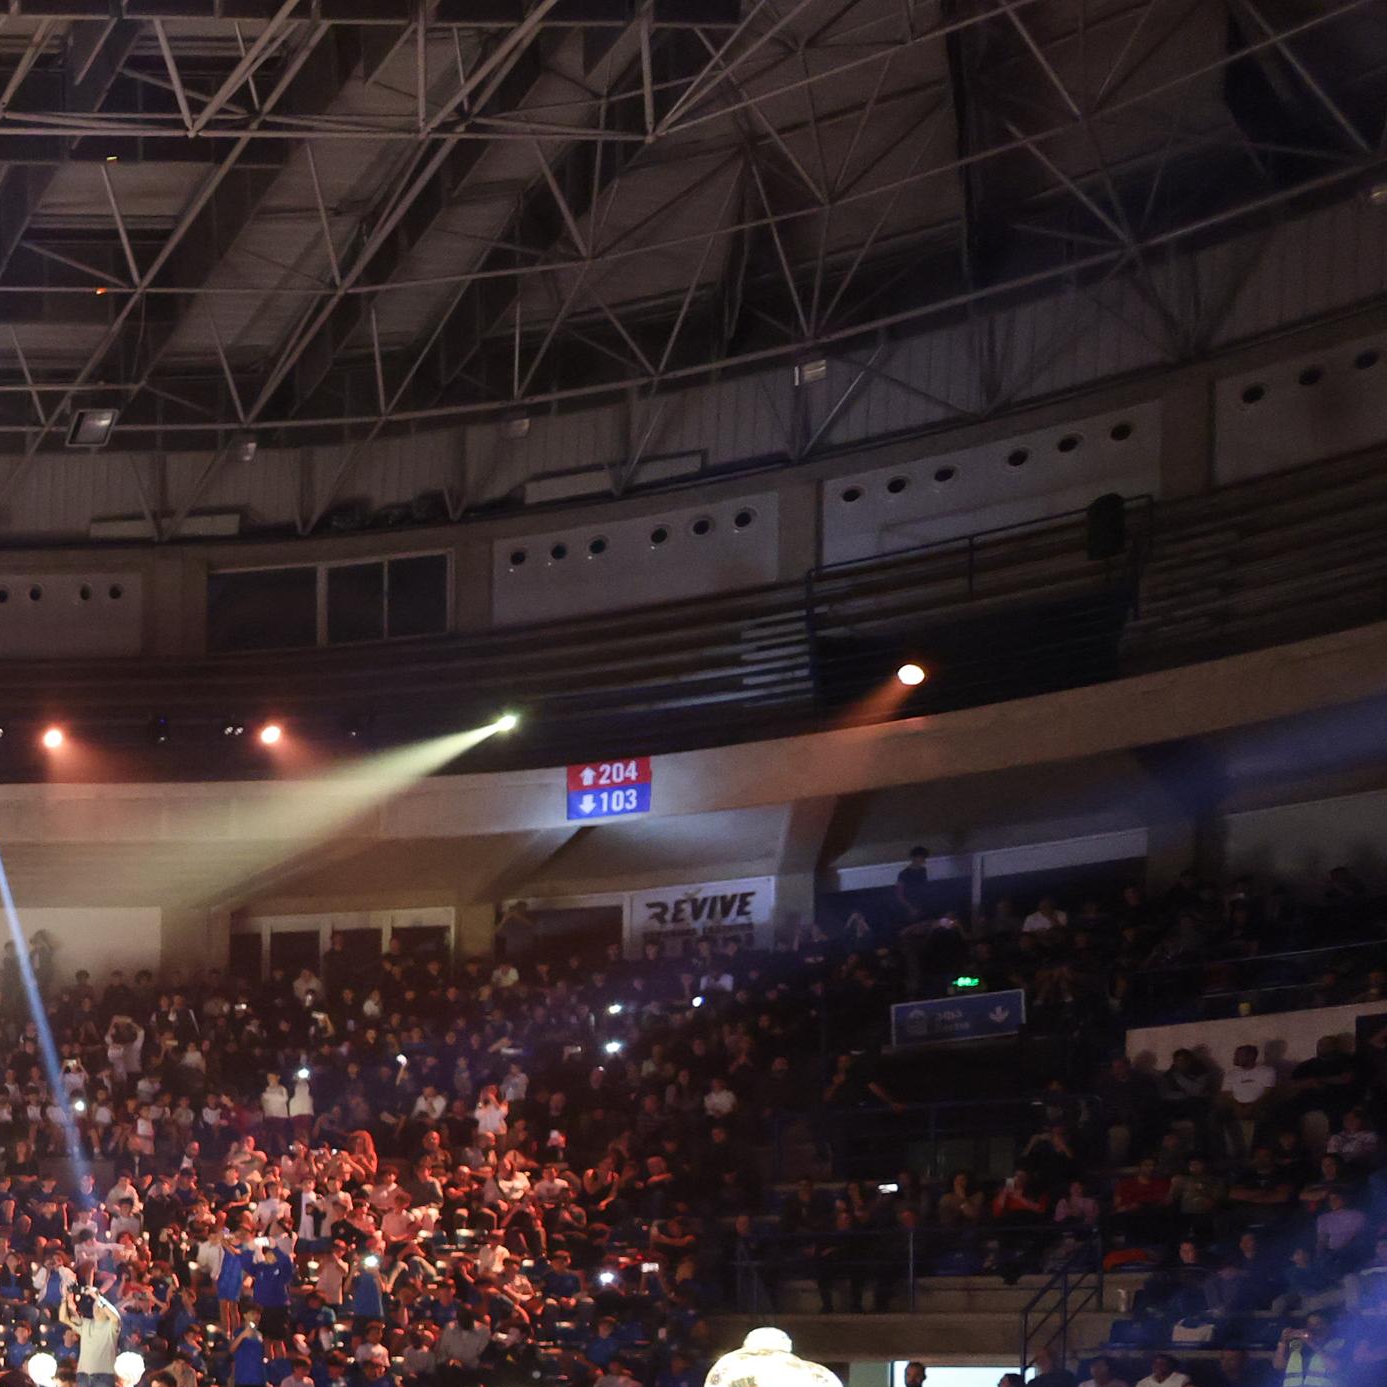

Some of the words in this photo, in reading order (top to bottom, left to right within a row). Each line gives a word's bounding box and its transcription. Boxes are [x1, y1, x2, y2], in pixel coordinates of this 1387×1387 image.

[599, 760, 638, 784] 204
[600, 788, 637, 812] 103
[645, 891, 756, 925] REVIVE
